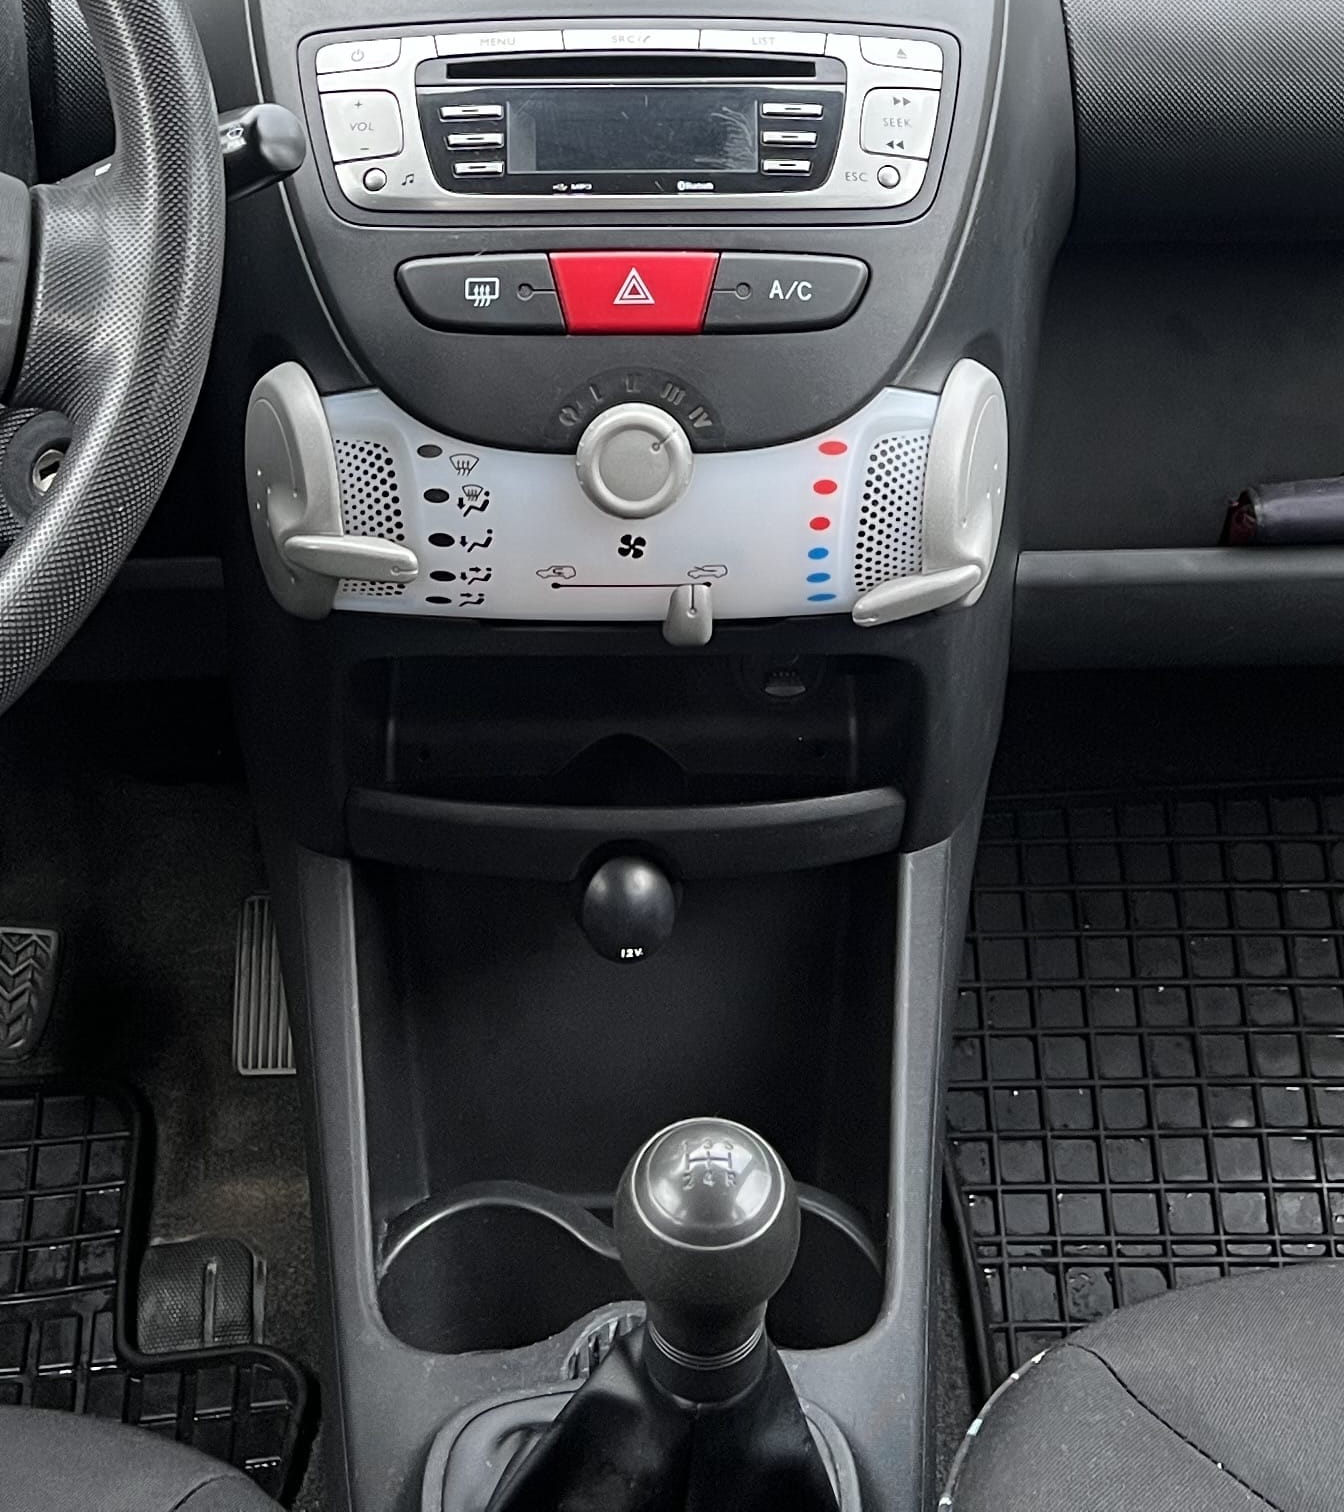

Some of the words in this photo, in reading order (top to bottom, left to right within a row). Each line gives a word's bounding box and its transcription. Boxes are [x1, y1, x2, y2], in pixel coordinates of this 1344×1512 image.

[479, 37, 517, 47] MENU
[750, 36, 776, 46] LIST
[349, 122, 375, 132] VOL
[882, 117, 912, 128] SEEK
[844, 171, 868, 182] ESC
[768, 279, 813, 301] A/C
[659, 382, 687, 406] III
[688, 406, 713, 429] IV
[621, 947, 643, 958] 12V
